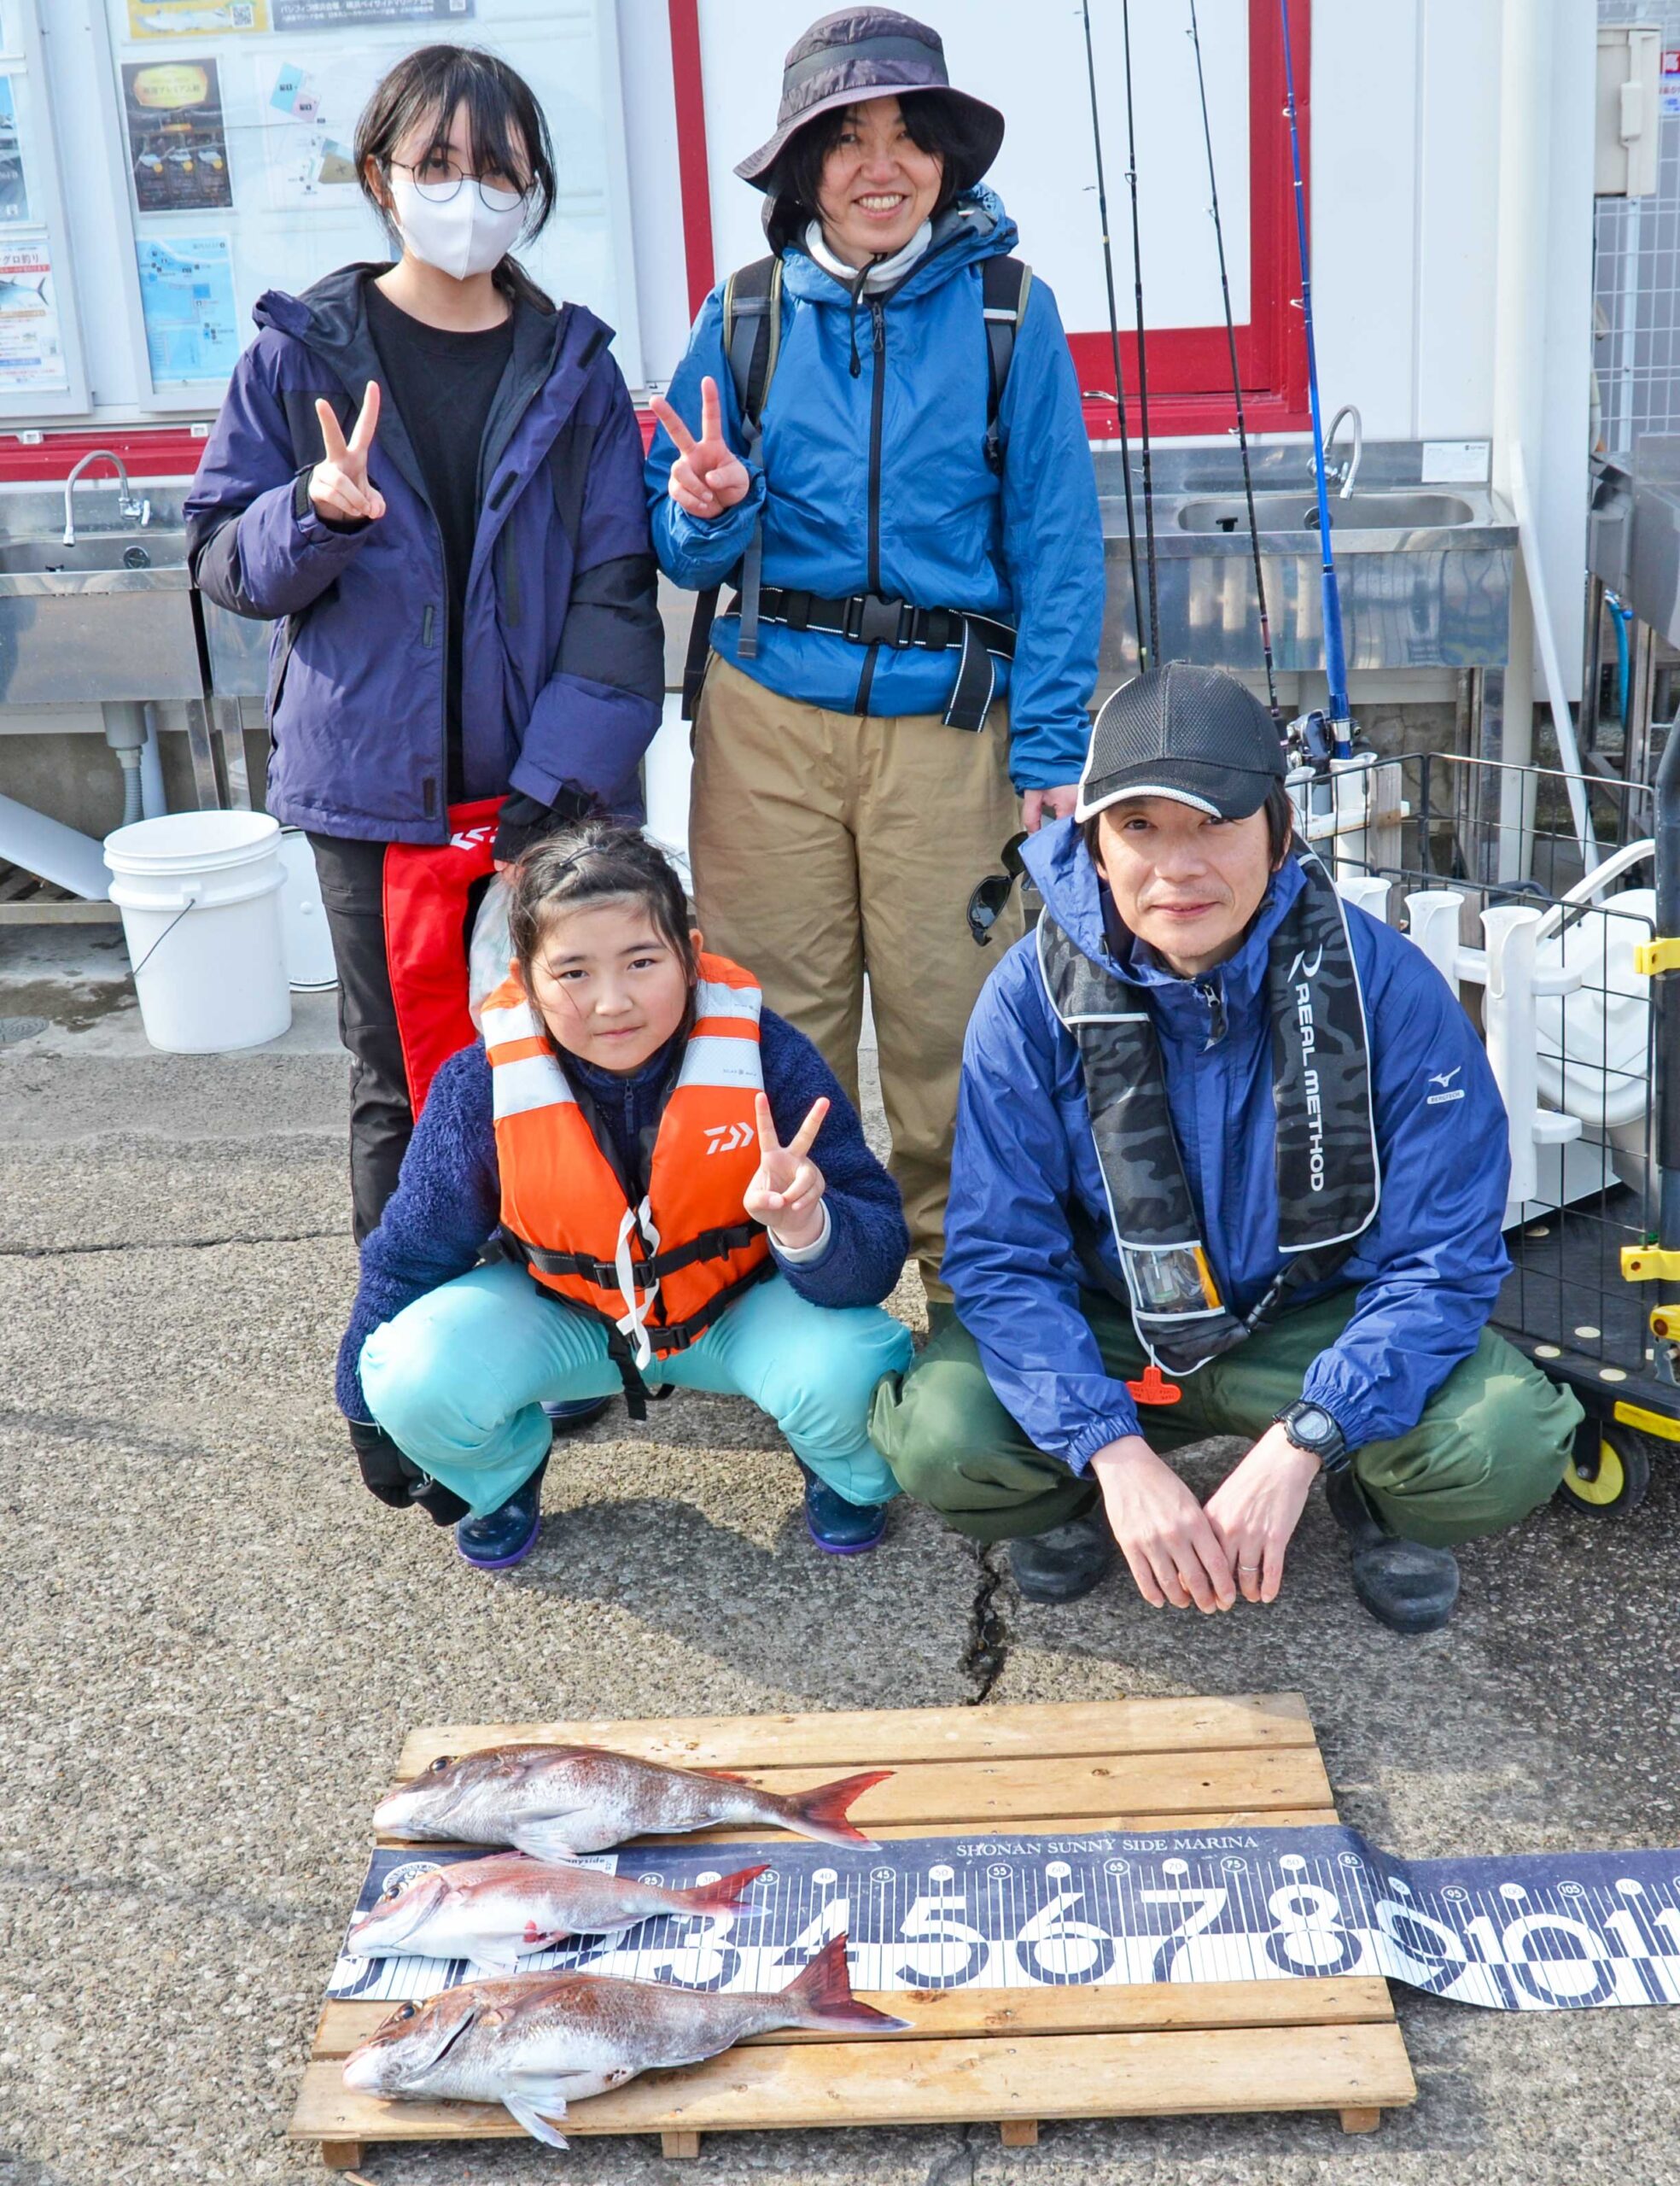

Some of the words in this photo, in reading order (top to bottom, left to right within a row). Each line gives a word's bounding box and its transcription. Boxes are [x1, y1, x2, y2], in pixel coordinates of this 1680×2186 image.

[0, 253, 39, 266] グロ釣り
[1296, 983, 1315, 1067] REAL
[1304, 1070, 1324, 1192] METHOD
[644, 1876, 657, 1885] 25
[819, 1872, 832, 1880] 40
[877, 1870, 890, 1879] 45
[936, 1868, 948, 1877] 50
[993, 1867, 1006, 1875] 55
[1052, 1865, 1065, 1873] 60
[1110, 1862, 1123, 1872] 65
[1227, 1860, 1241, 1868] 75
[1345, 1855, 1358, 1865] 85
[1447, 1889, 1462, 1899] 95
[1503, 1886, 1521, 1896] 100
[1560, 1885, 1580, 1894] 105
[1619, 1882, 1638, 1892] 110
[957, 1844, 1041, 1857] SHONAN
[1047, 1839, 1116, 1854] SUNNY
[1123, 1838, 1167, 1851] SIDE
[1174, 1836, 1258, 1850] MARINA
[654, 1914, 742, 1992] 3
[772, 1898, 859, 1967] 4
[895, 1896, 989, 1989] 5
[1016, 1892, 1116, 1984] 6
[1140, 1888, 1227, 1983] 7
[1265, 1884, 1362, 1977] 8
[1375, 1899, 1467, 1994] 9
[1463, 1914, 1617, 2008] 10
